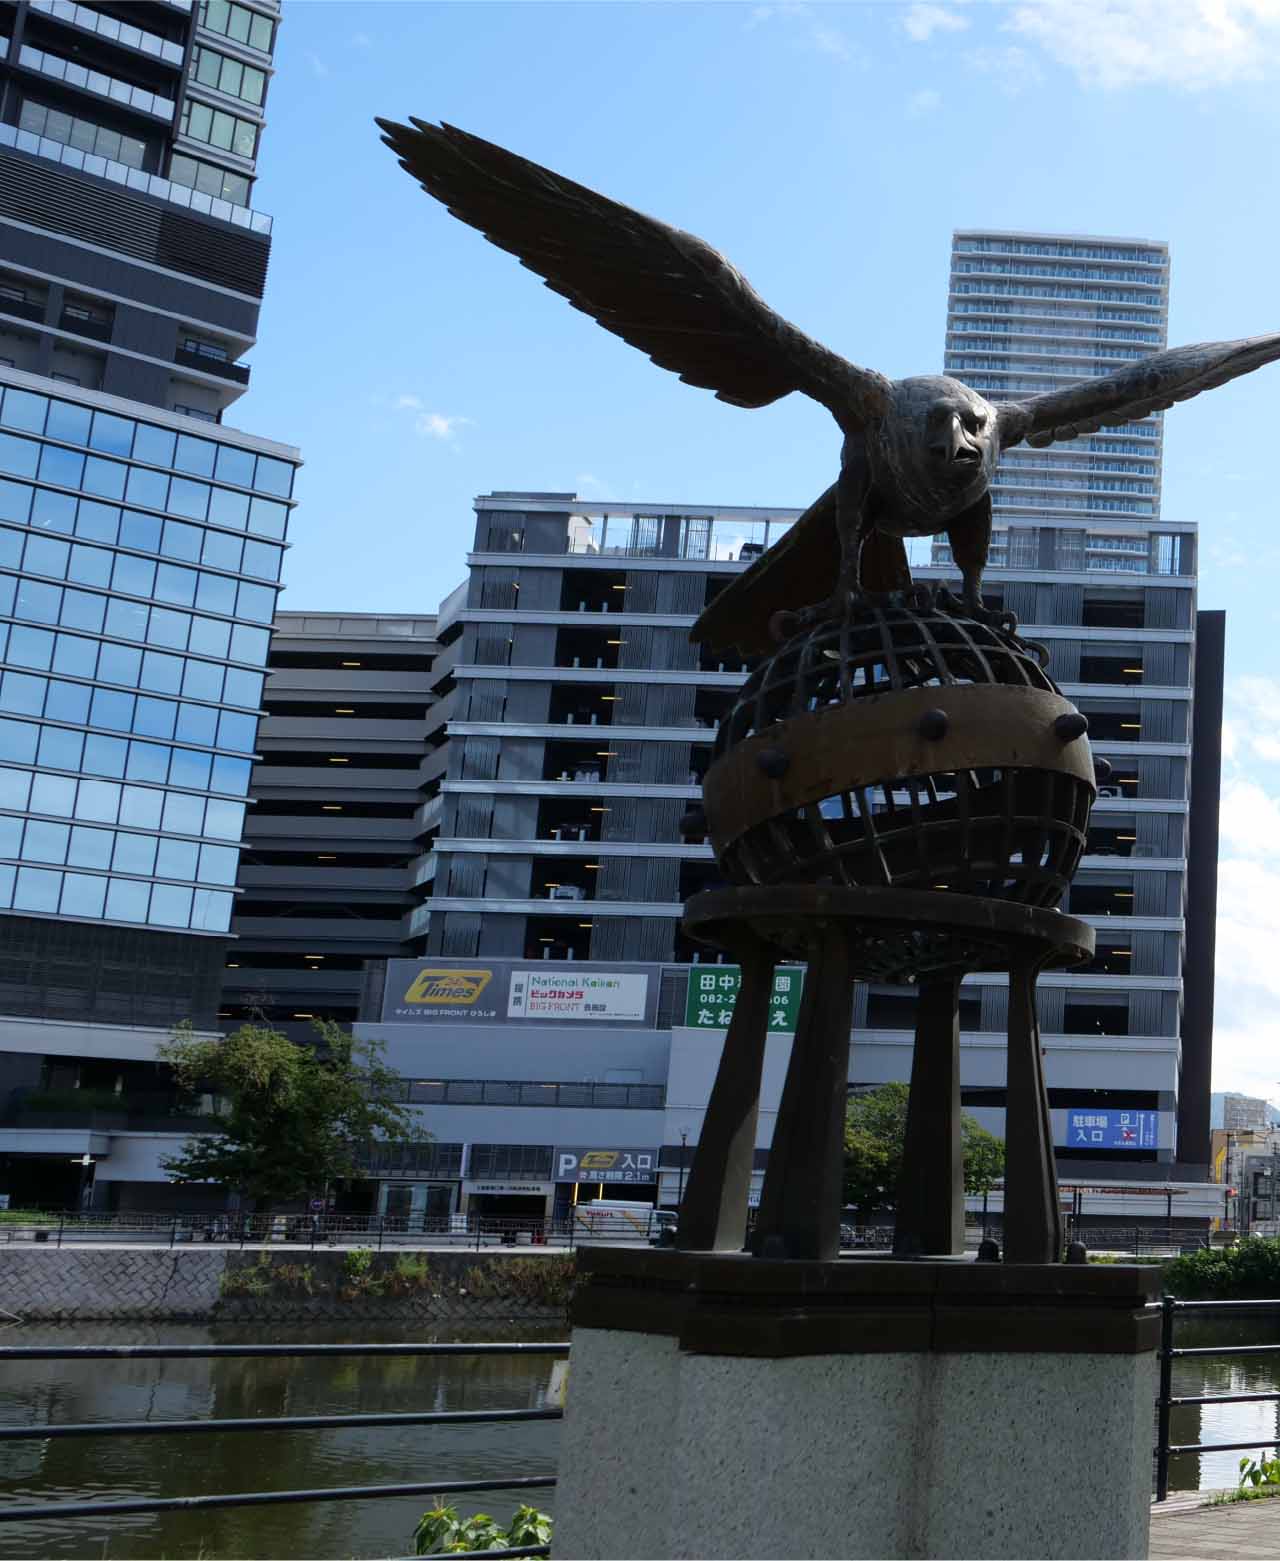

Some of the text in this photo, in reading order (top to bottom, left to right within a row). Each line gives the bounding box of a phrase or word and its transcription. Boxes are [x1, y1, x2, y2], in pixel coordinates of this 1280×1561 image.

[418, 975, 484, 998] Times
[532, 976, 620, 988] National Kaikan
[531, 990, 584, 999] ビックカメラ
[440, 1009, 468, 1017] FRONT
[470, 1009, 496, 1017] ひろしま
[548, 1002, 579, 1012] FRONT
[1073, 1115, 1108, 1128] 駐車場
[1076, 1129, 1104, 1142] 入口
[558, 1153, 577, 1177] P
[621, 1153, 652, 1169] 入口
